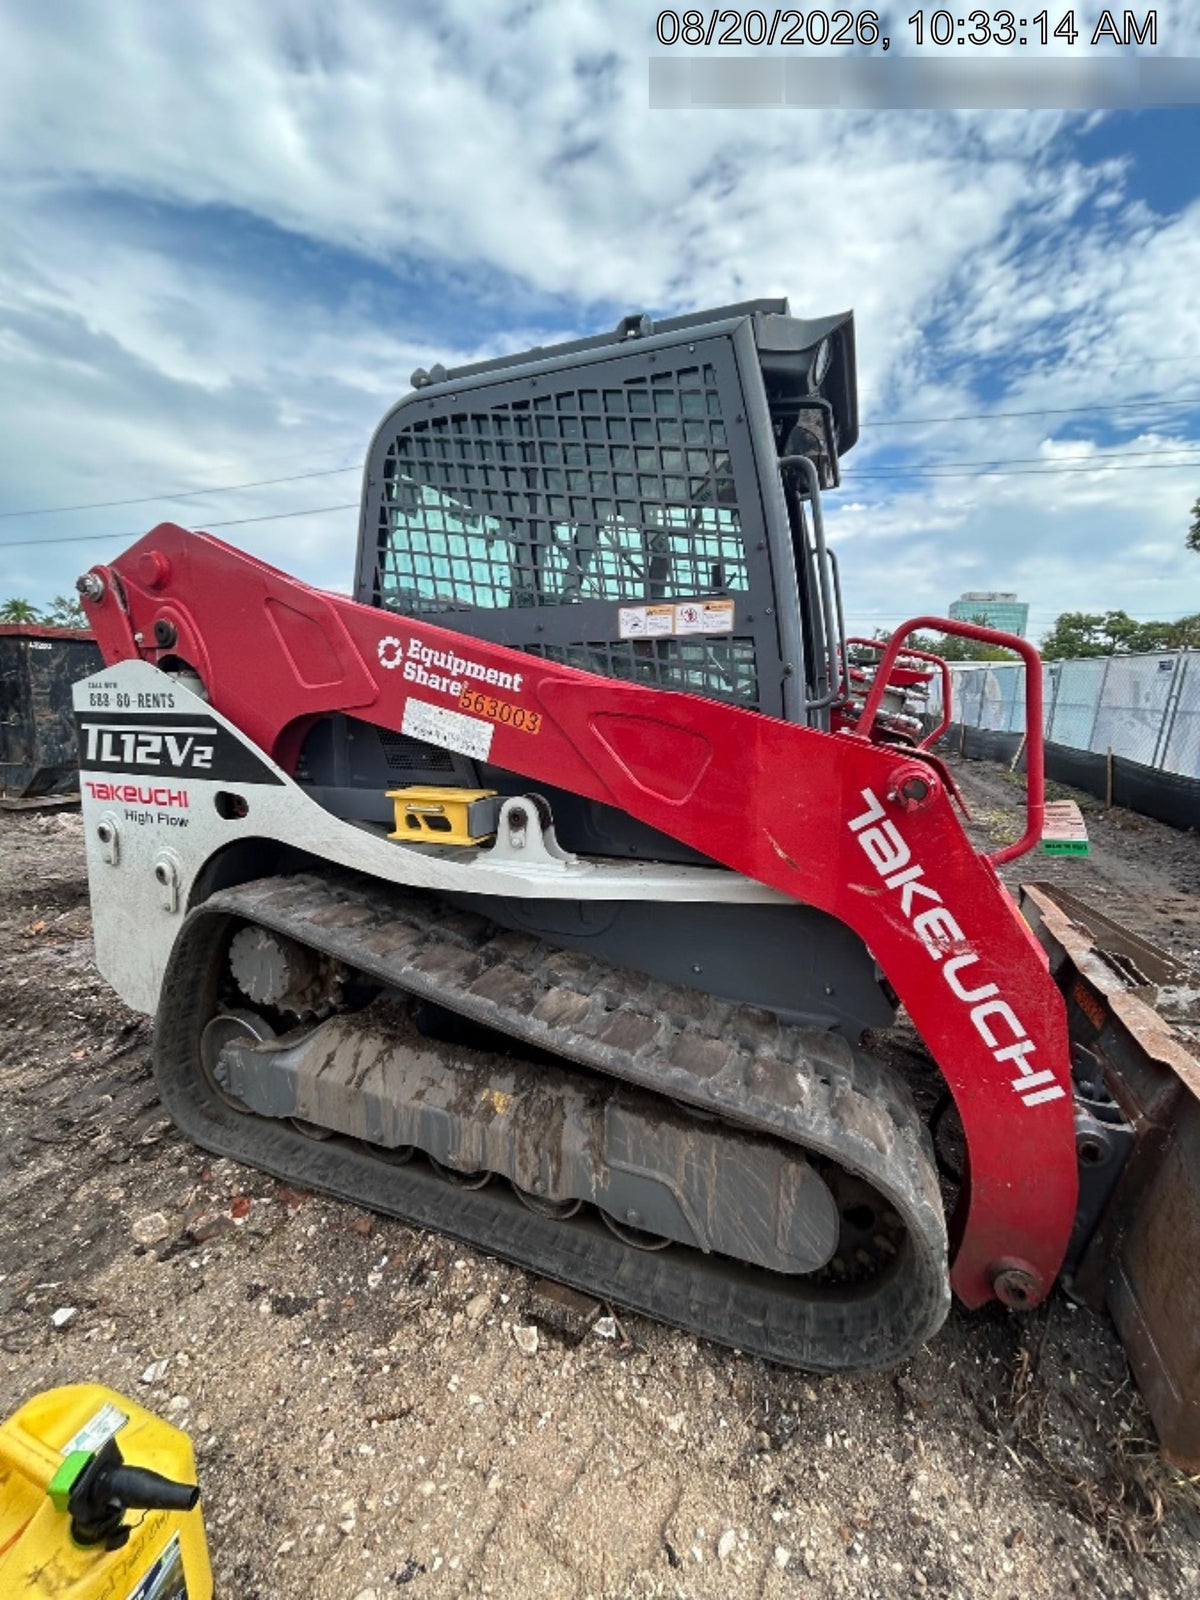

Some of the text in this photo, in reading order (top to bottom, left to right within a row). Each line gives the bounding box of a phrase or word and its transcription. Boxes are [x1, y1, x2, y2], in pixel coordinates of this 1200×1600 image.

[402, 660, 462, 697] Share
[406, 637, 524, 692] Equipment
[461, 690, 540, 732] 563003
[85, 781, 190, 808] TAKEUCHI
[124, 809, 189, 828] High Flow
[848, 786, 1067, 1108] TAKEUCHI
